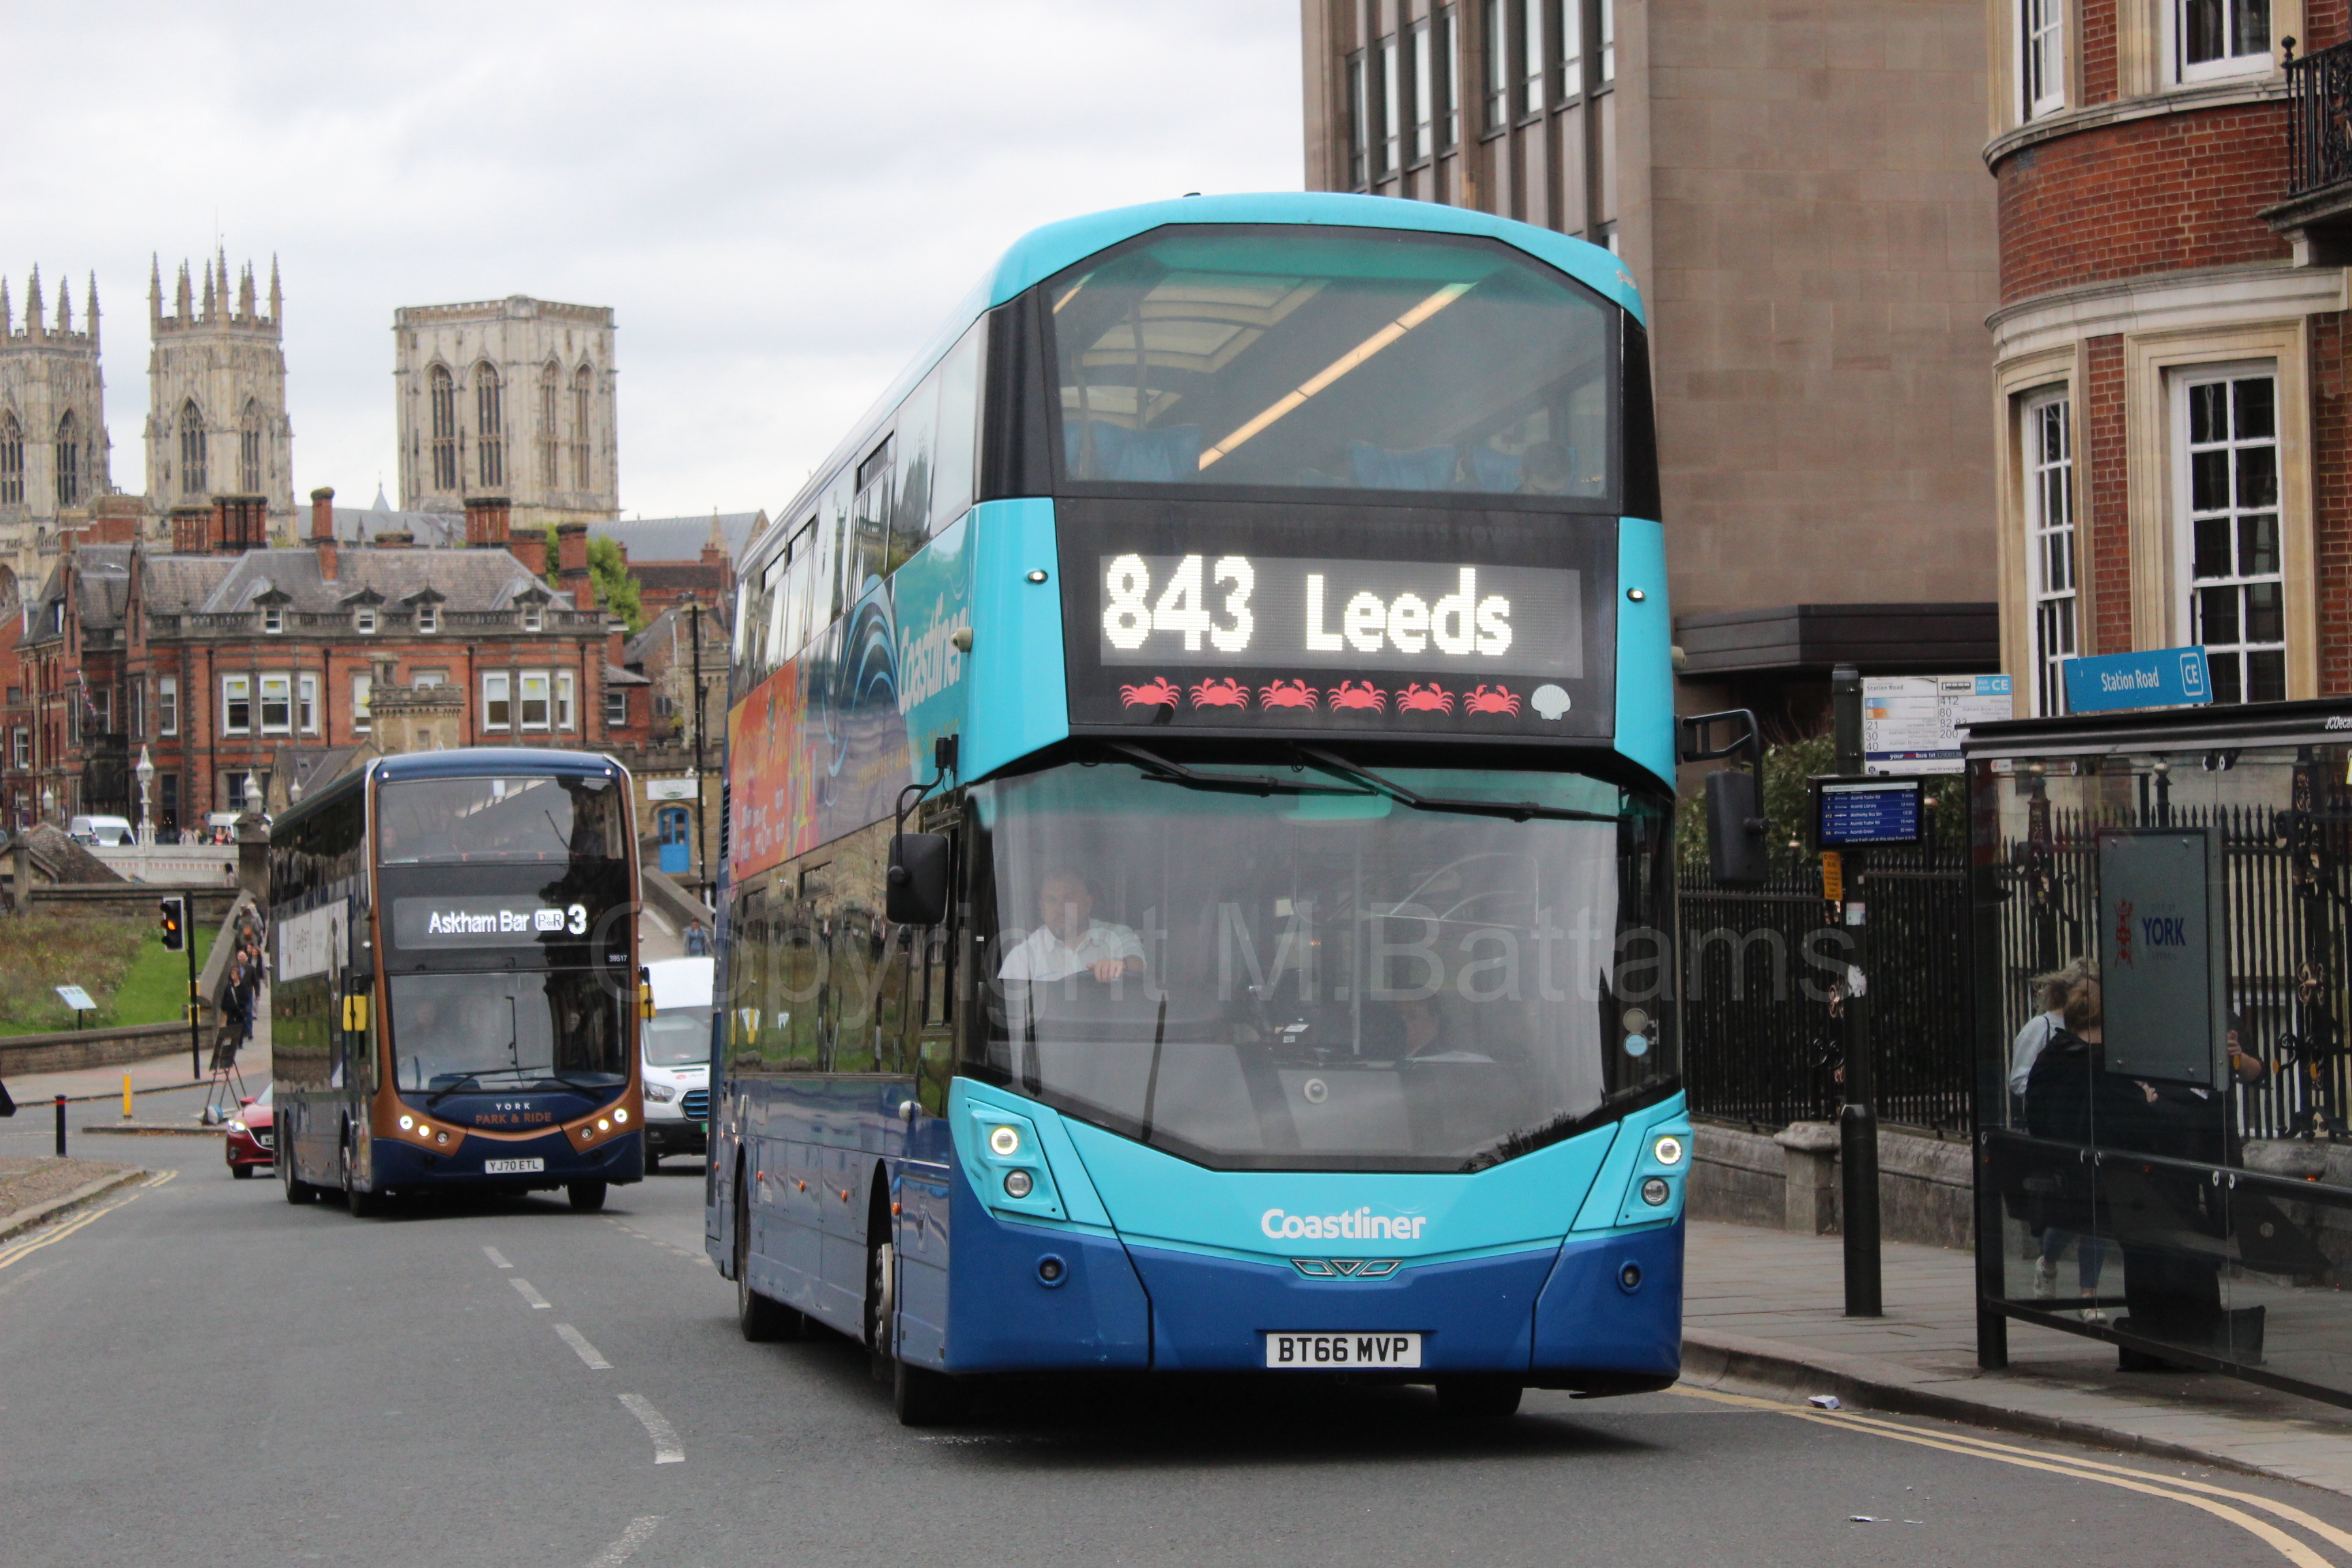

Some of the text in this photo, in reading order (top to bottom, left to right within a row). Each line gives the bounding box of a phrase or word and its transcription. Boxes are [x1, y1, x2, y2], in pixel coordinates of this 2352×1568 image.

[1103, 554, 1512, 655] 843 Leeds
[898, 592, 966, 716] Coastliner
[2101, 666, 2159, 692] Station Road
[2185, 664, 2200, 685] CE
[1991, 679, 2009, 691] CE
[1867, 699, 1874, 708] 4
[1940, 696, 1959, 706] 412
[1940, 708, 1952, 717] 80
[1867, 721, 1878, 730] 21
[1940, 719, 1952, 728] 82
[2325, 716, 2352, 730] JCDeca
[1865, 732, 1878, 741] 30
[1940, 730, 1959, 738] 200
[1866, 742, 1879, 751] 40
[428, 903, 587, 935] Askham Bar P&R 3
[2142, 917, 2187, 946] YORK
[608, 954, 627, 963] 39517
[495, 1102, 531, 1111] YORK
[476, 1112, 553, 1124] PARK & RIDE
[490, 1160, 539, 1171] YJ70 ETL
[1261, 1206, 1426, 1239] Coastliner
[1279, 1337, 1409, 1362] BT66 MVP
